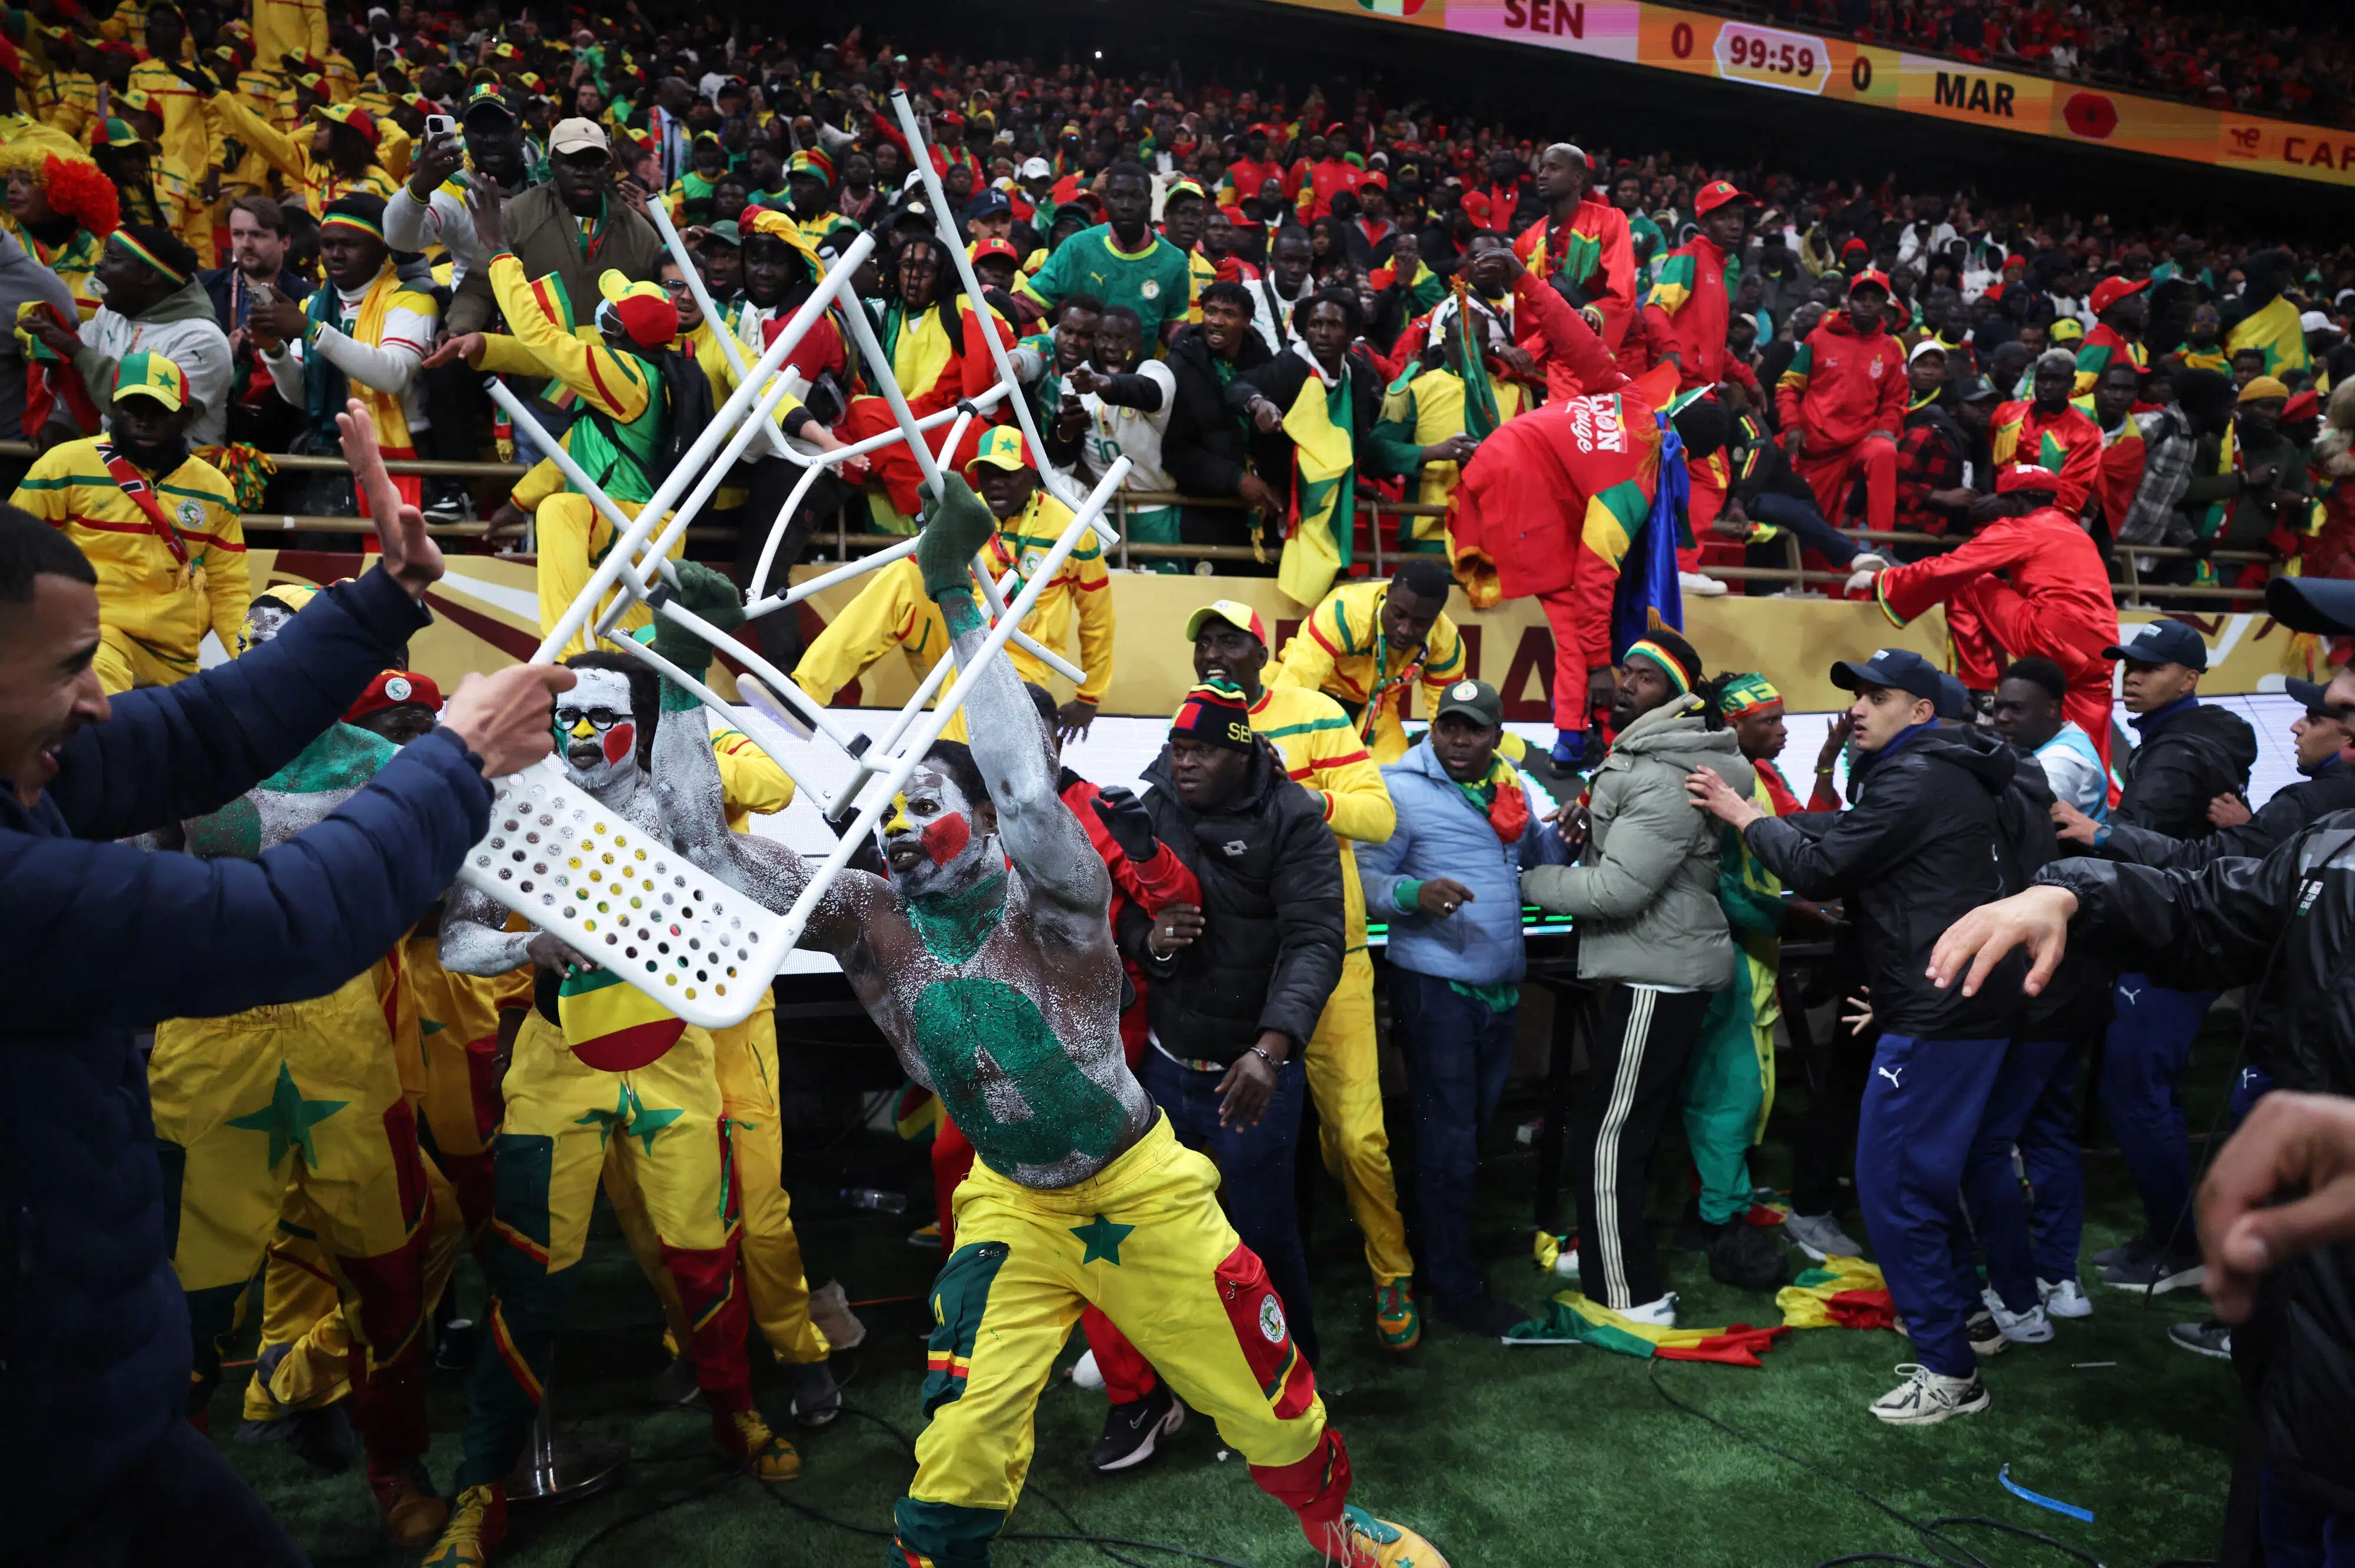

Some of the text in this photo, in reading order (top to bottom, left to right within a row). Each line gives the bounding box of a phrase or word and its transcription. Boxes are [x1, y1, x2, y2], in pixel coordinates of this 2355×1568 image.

[1503, 0, 2015, 117] SEN 0 99:59 0 MAR
[1093, 437, 1122, 464] 10
[1590, 393, 1621, 453] LION
